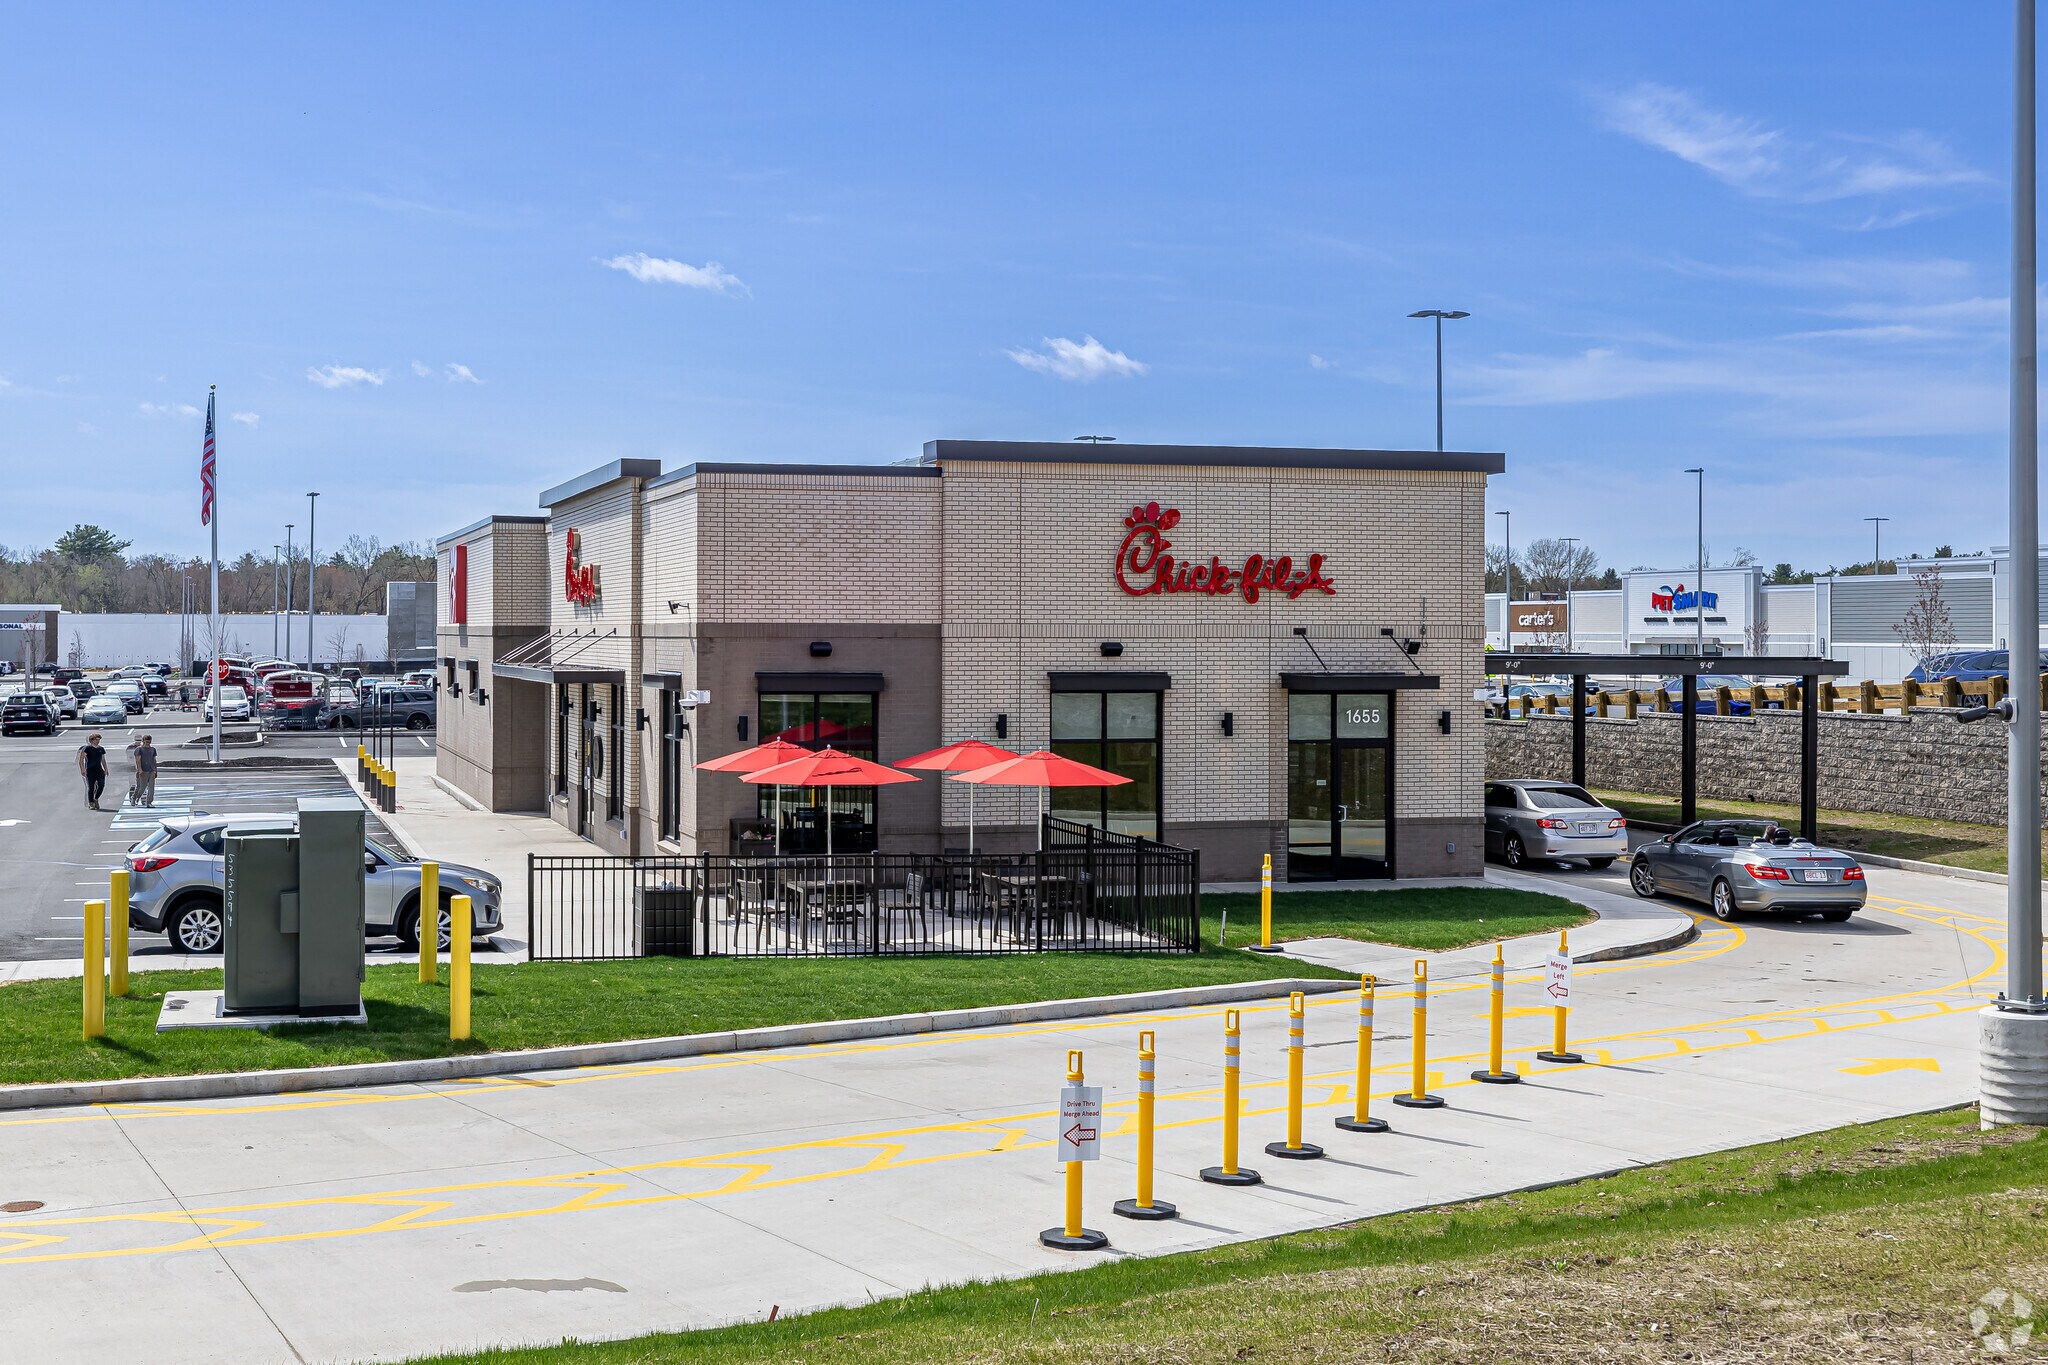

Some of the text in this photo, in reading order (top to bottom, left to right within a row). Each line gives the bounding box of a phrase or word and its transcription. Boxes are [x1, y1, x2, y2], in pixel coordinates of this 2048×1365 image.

[1116, 501, 1336, 604] Chick-fil-A
[1519, 611, 1554, 626] carter's
[209, 665, 228, 673] SOP
[1346, 709, 1380, 723] 1655
[1550, 960, 1568, 970] Merge
[1553, 972, 1565, 980] Left
